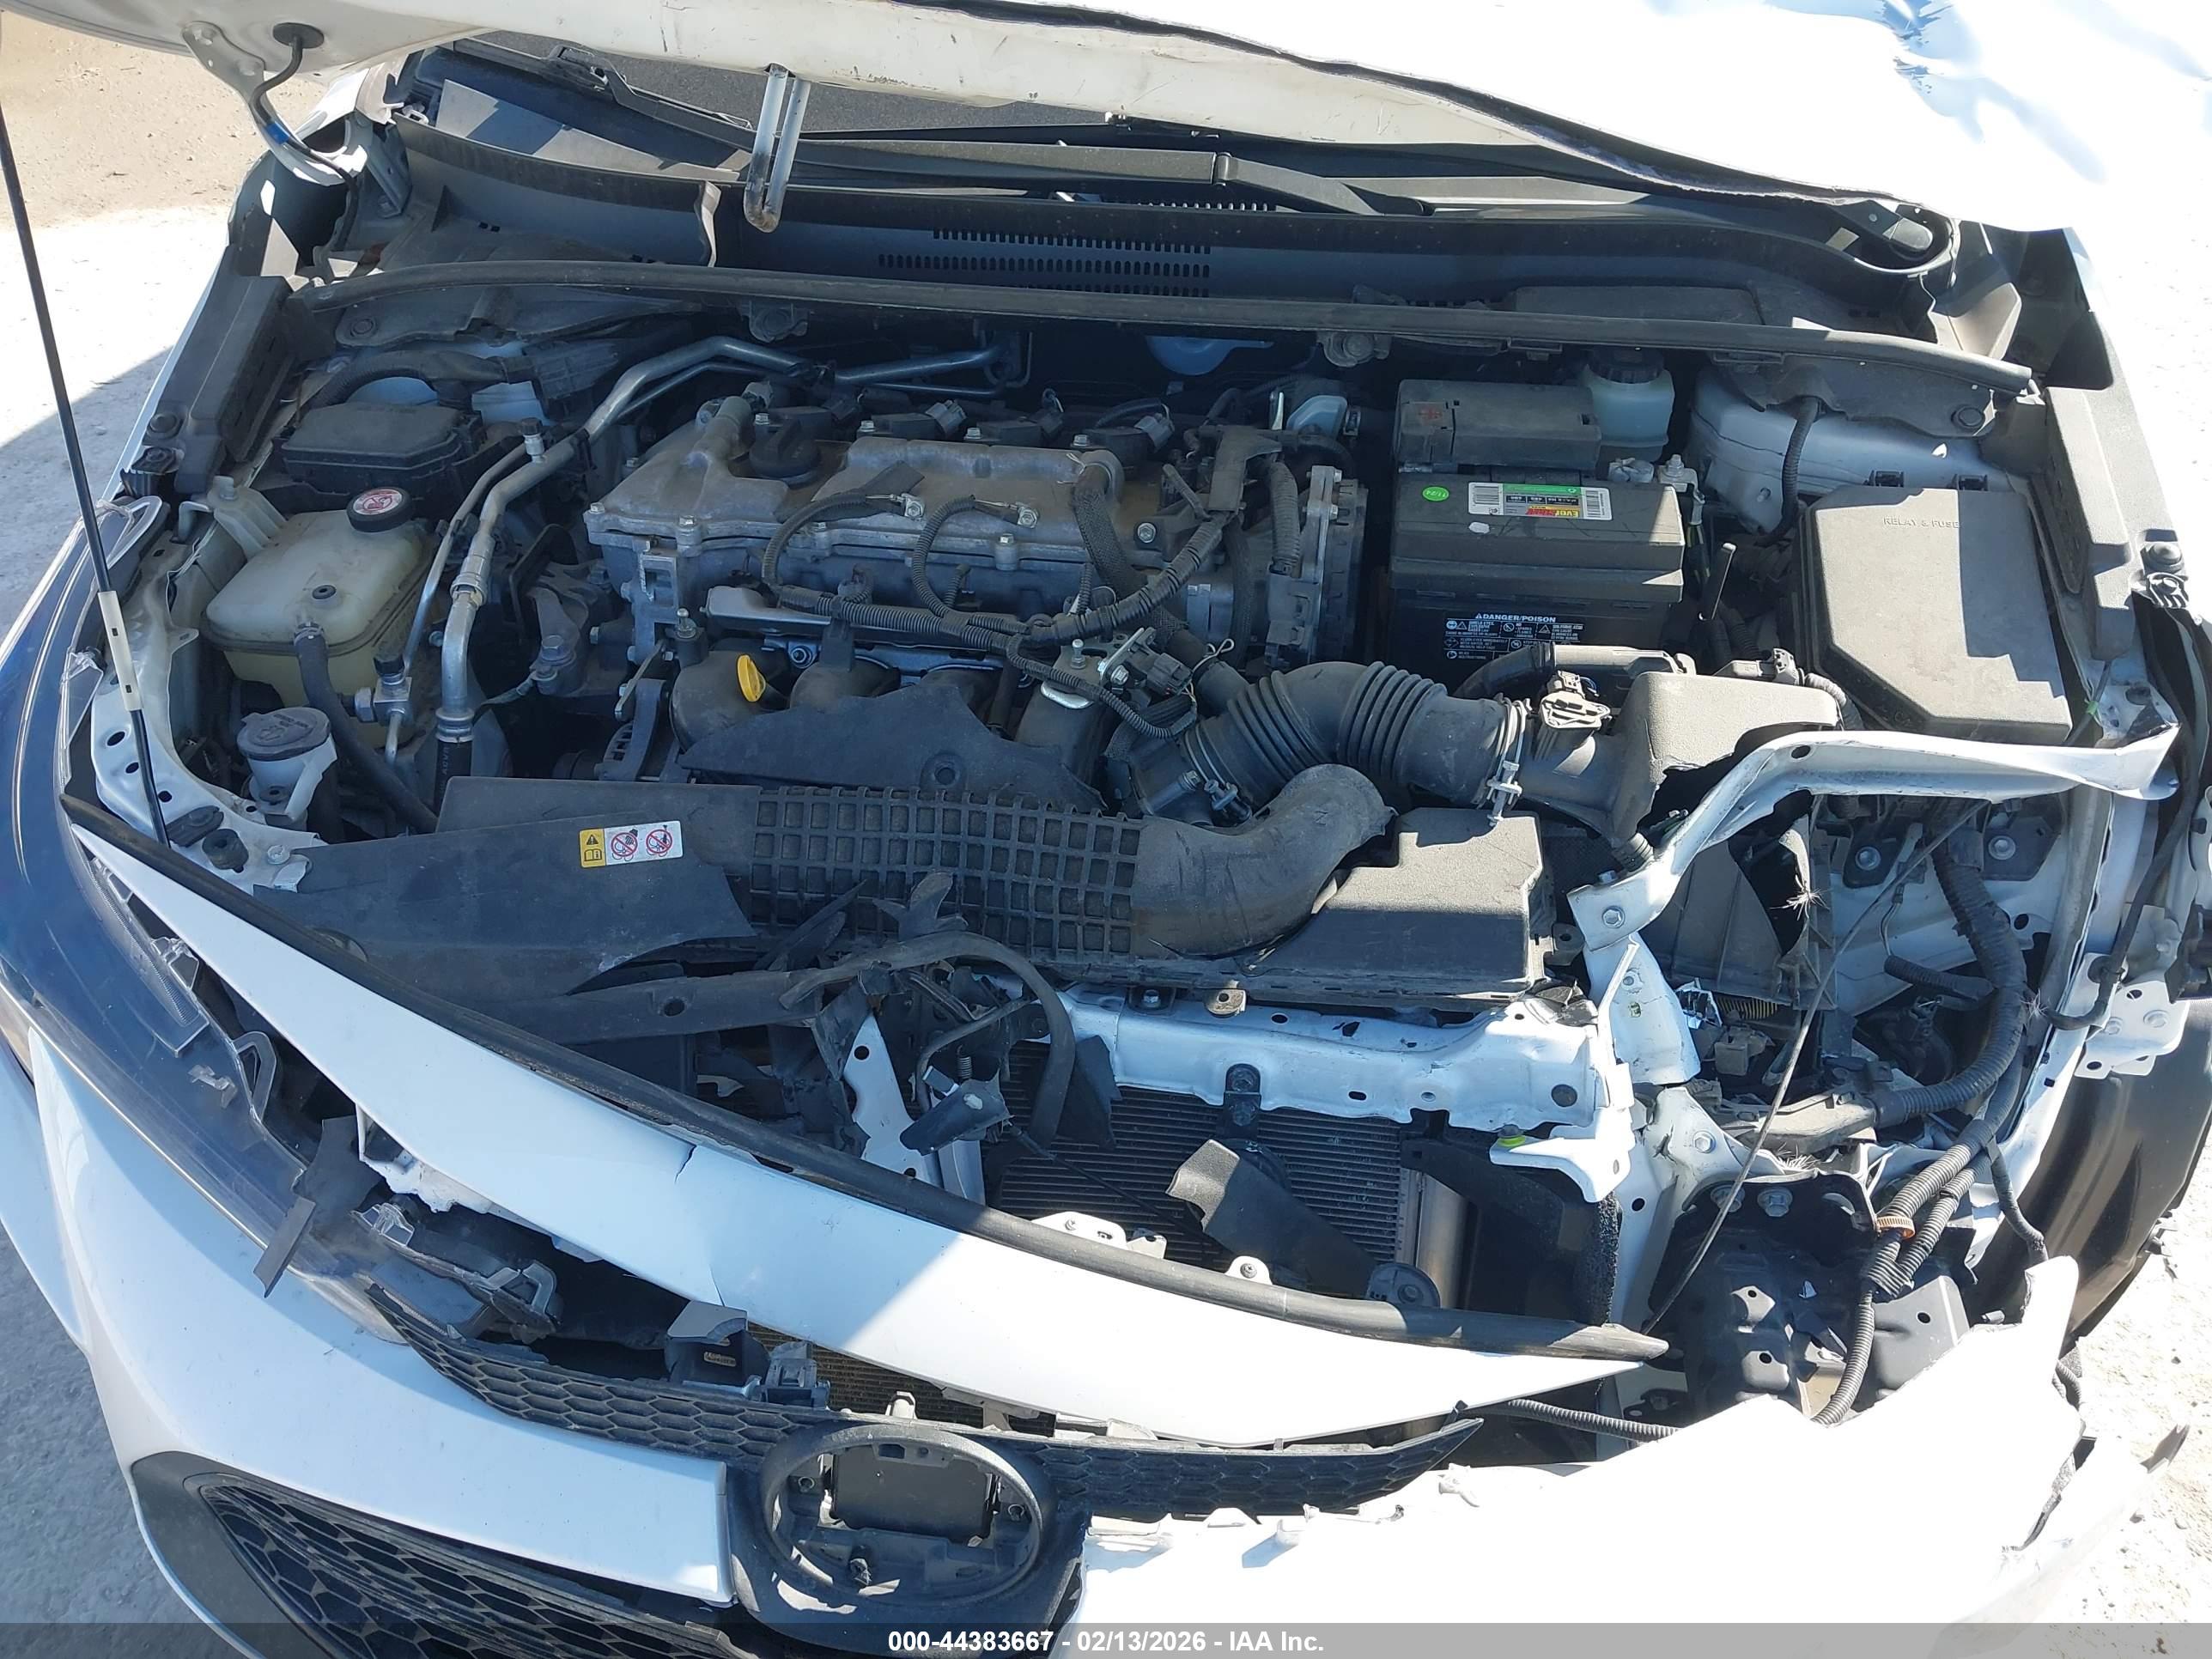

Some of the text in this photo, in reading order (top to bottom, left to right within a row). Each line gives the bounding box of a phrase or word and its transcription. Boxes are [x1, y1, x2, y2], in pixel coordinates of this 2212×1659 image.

[1883, 516, 1917, 527] RELAY
[1931, 519, 1962, 529] FUSE
[1483, 613, 1557, 623] DANGER/POISON
